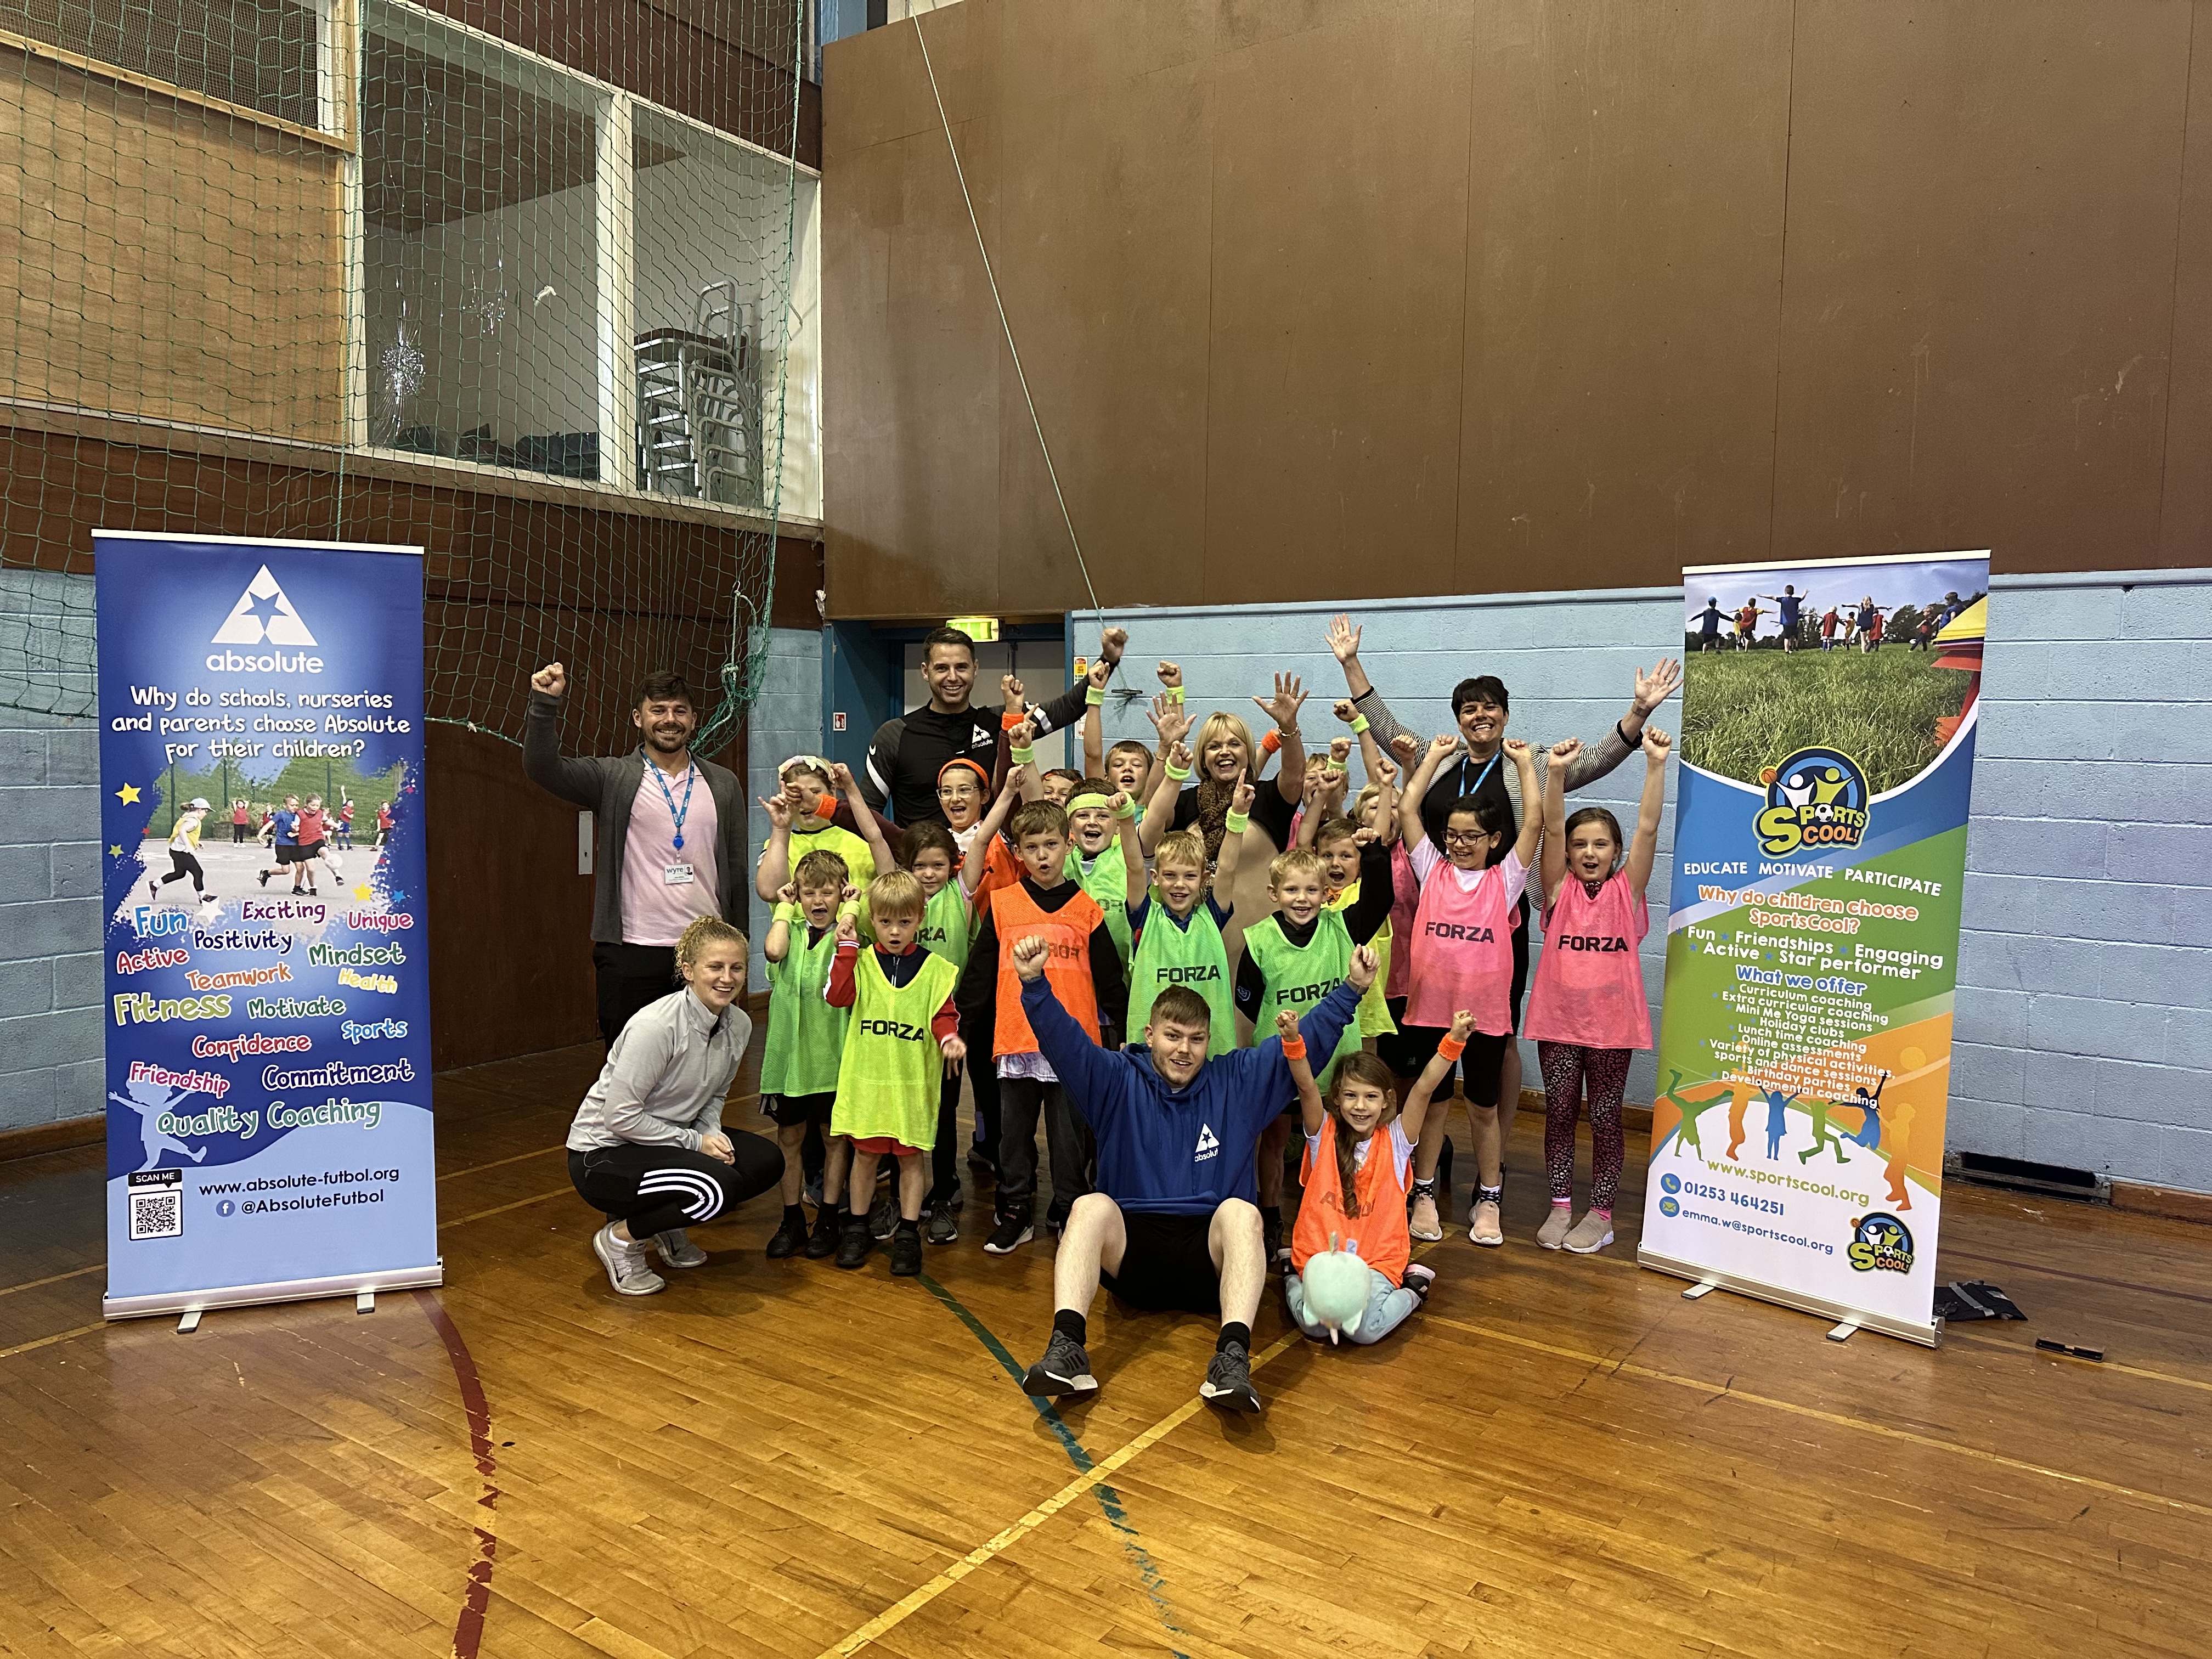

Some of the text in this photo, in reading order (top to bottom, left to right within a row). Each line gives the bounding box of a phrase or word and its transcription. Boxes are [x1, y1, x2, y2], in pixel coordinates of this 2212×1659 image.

[206, 650, 324, 673] absolute
[131, 686, 393, 711] Why do schools, nurseries
[112, 713, 410, 735] and parents choose Absolute
[208, 738, 264, 758] their
[273, 739, 365, 758] children?
[1684, 862, 1942, 897] EDUCATE MOTIVATE PARTICIPATE
[242, 900, 327, 924] Exciting
[1699, 885, 1919, 921] Why do children choose
[134, 906, 188, 936] Fun
[347, 911, 413, 933] Unique
[1425, 922, 1494, 944] FORZA
[1749, 908, 1861, 934] SportsCool?
[193, 930, 293, 955] Positivity
[308, 943, 407, 967] Mindset
[1558, 935, 1629, 952] FORZA
[1688, 926, 1943, 969] Fun Friendships Engaging
[116, 946, 189, 975] Active
[1156, 965, 1221, 983] FORZA
[1703, 941, 1921, 980] Active Star performer
[185, 963, 293, 991] Teamwork
[337, 968, 398, 995] Health
[1735, 964, 1867, 997] What we offer
[1277, 978, 1340, 1005] FORZA
[1740, 984, 1872, 1012] Curriculum coaching
[114, 992, 232, 1026] Fitness
[246, 996, 346, 1020] Motivate
[1723, 991, 1888, 1026] Extra curricular coaching
[1736, 1004, 1872, 1032] Mini Me Yoga sessions
[860, 1019, 924, 1043] FORZA
[1738, 1024, 1867, 1054] Lunch time coaching
[1759, 1017, 1845, 1039] Holiday clubs
[192, 1034, 312, 1063] Confidence
[1709, 1039, 1896, 1079] Variety of physical activities,
[1742, 1034, 1861, 1062] Online assessments
[129, 1060, 230, 1099] Friendship
[261, 1058, 415, 1091] Commitment
[1714, 1050, 1877, 1086] sports and dance sessions
[1747, 1065, 1850, 1092] Birthday parties
[1722, 1071, 1877, 1109] Developmental coaching
[156, 1097, 381, 1139] Quality Coaching
[1195, 1148, 1218, 1161] absolut
[136, 1172, 175, 1183] SCAN ME
[199, 1167, 399, 1196] www.absolute-futbol.org
[1707, 1160, 1870, 1207] www.sportscool.org
[241, 1189, 384, 1214] @AbsoluteFutbol
[1684, 1181, 1785, 1216] 01253 464251
[1682, 1208, 1833, 1255] emma.w@sportscool.org
